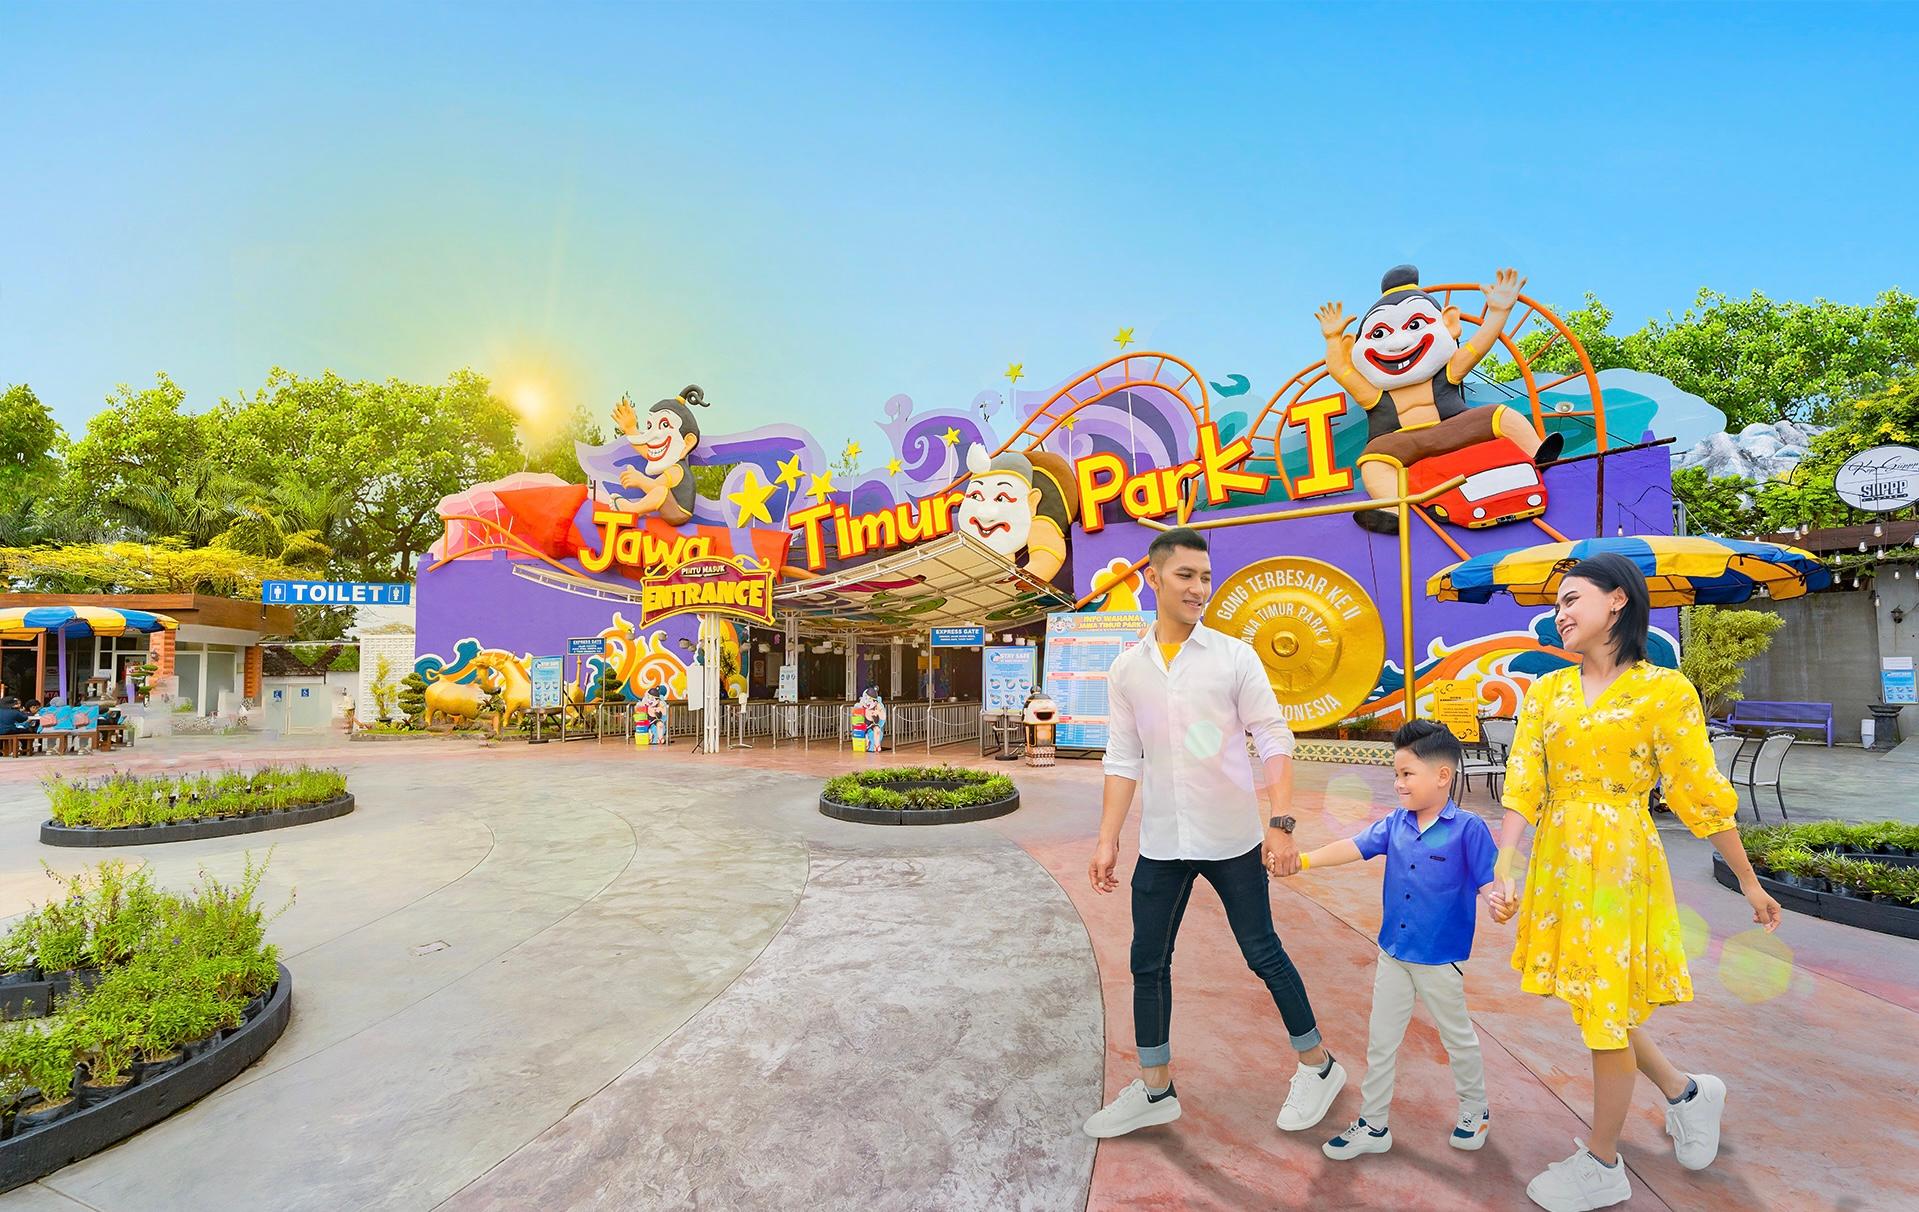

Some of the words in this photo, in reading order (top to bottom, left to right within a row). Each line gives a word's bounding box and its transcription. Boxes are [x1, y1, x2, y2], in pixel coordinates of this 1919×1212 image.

[577, 510, 711, 573] Jawa
[789, 490, 966, 571] Timur
[1074, 422, 1269, 533] Park
[681, 566, 701, 575] PINTU
[703, 565, 726, 574] MASUK
[292, 584, 384, 602] TOILET
[644, 580, 765, 613] ENTRANCE
[1216, 585, 1249, 621] GONG
[1246, 569, 1329, 596] TERBESAR
[1326, 585, 1353, 609] KE
[1342, 606, 1362, 621] II
[1241, 618, 1261, 645] AWA
[1256, 603, 1294, 623] TIMUR
[1298, 603, 1331, 638] PARK
[1279, 694, 1342, 721] ONESIA
